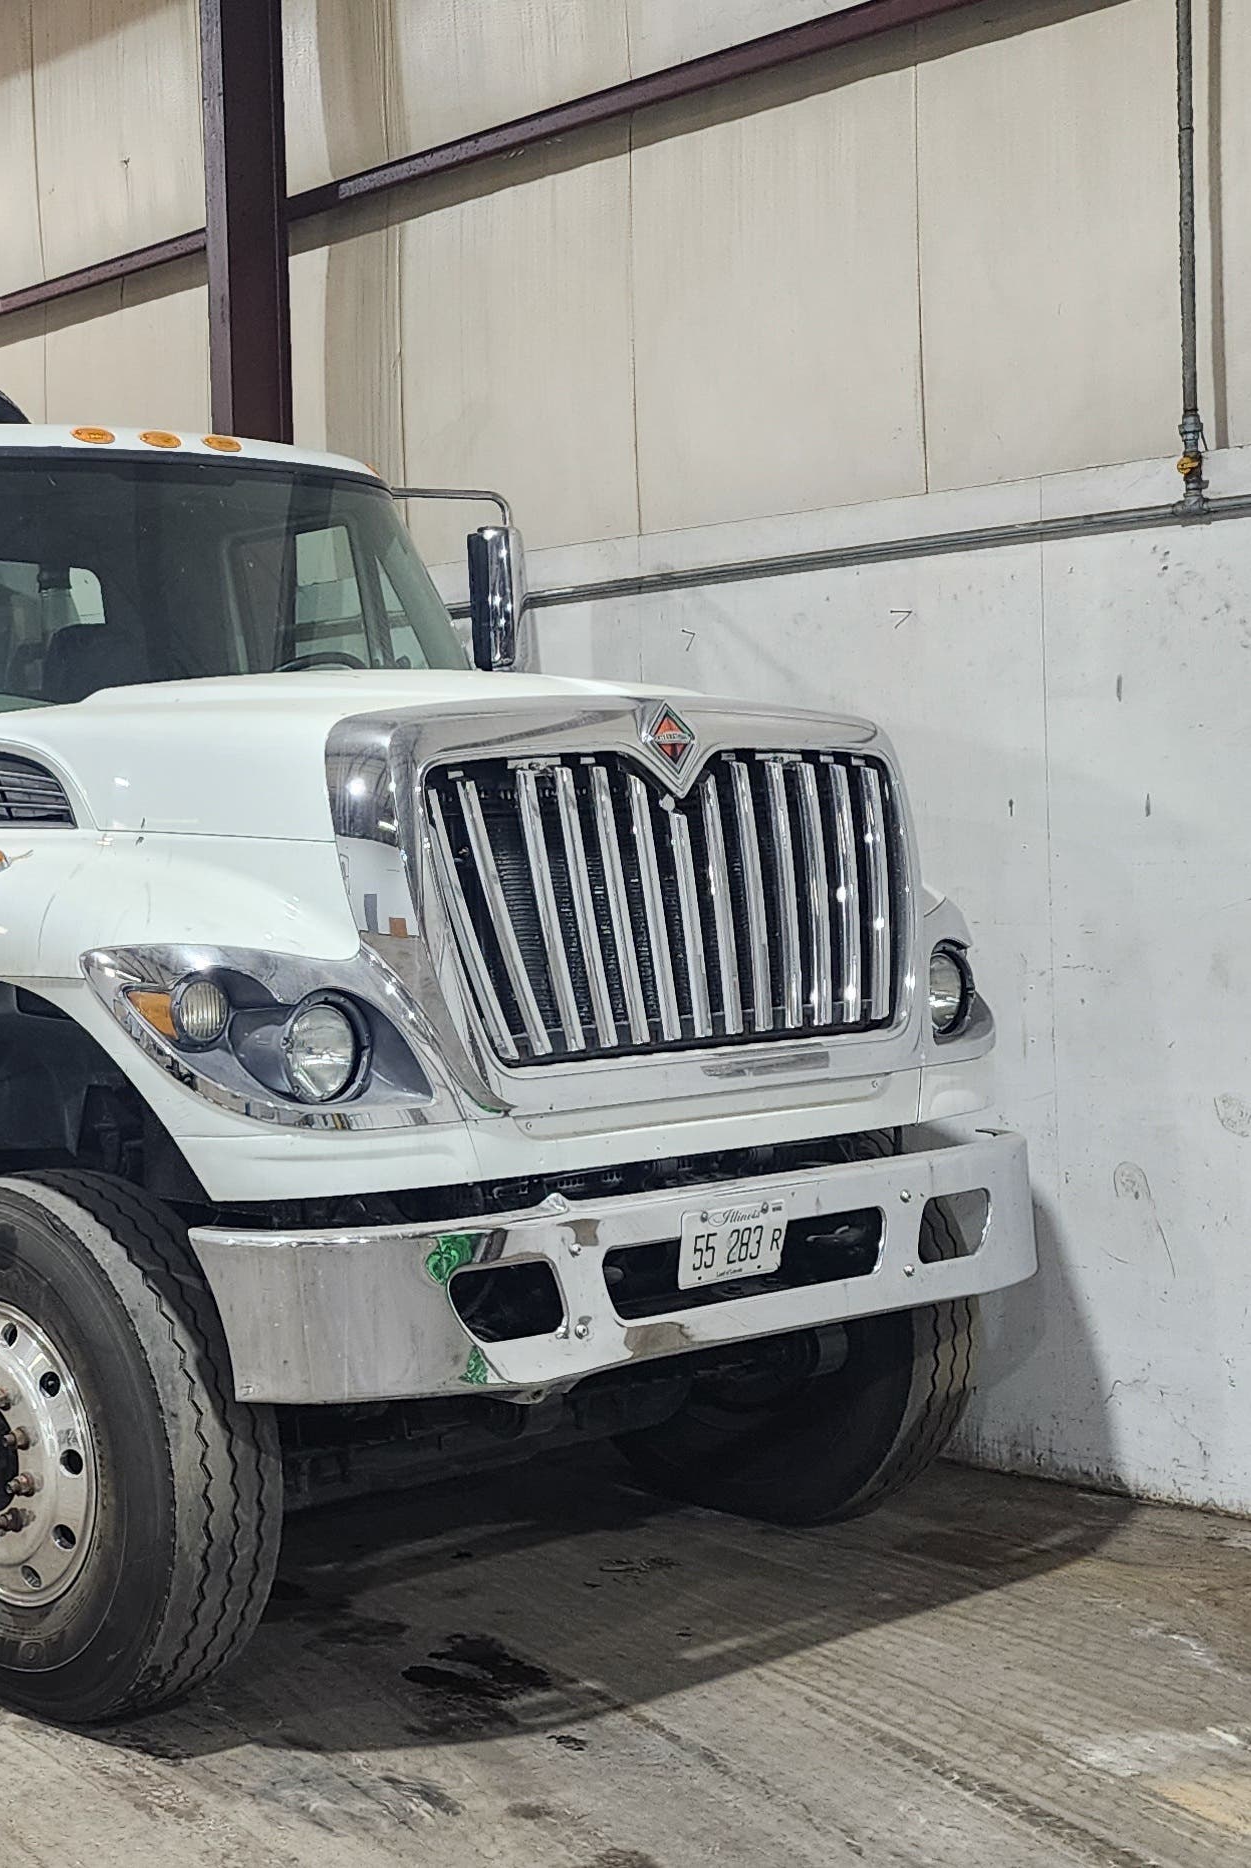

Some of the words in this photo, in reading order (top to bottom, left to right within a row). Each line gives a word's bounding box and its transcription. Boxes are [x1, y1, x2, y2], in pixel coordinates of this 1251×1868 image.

[692, 1232, 718, 1272] 55
[726, 1225, 764, 1265] 283
[769, 1228, 782, 1251] R
